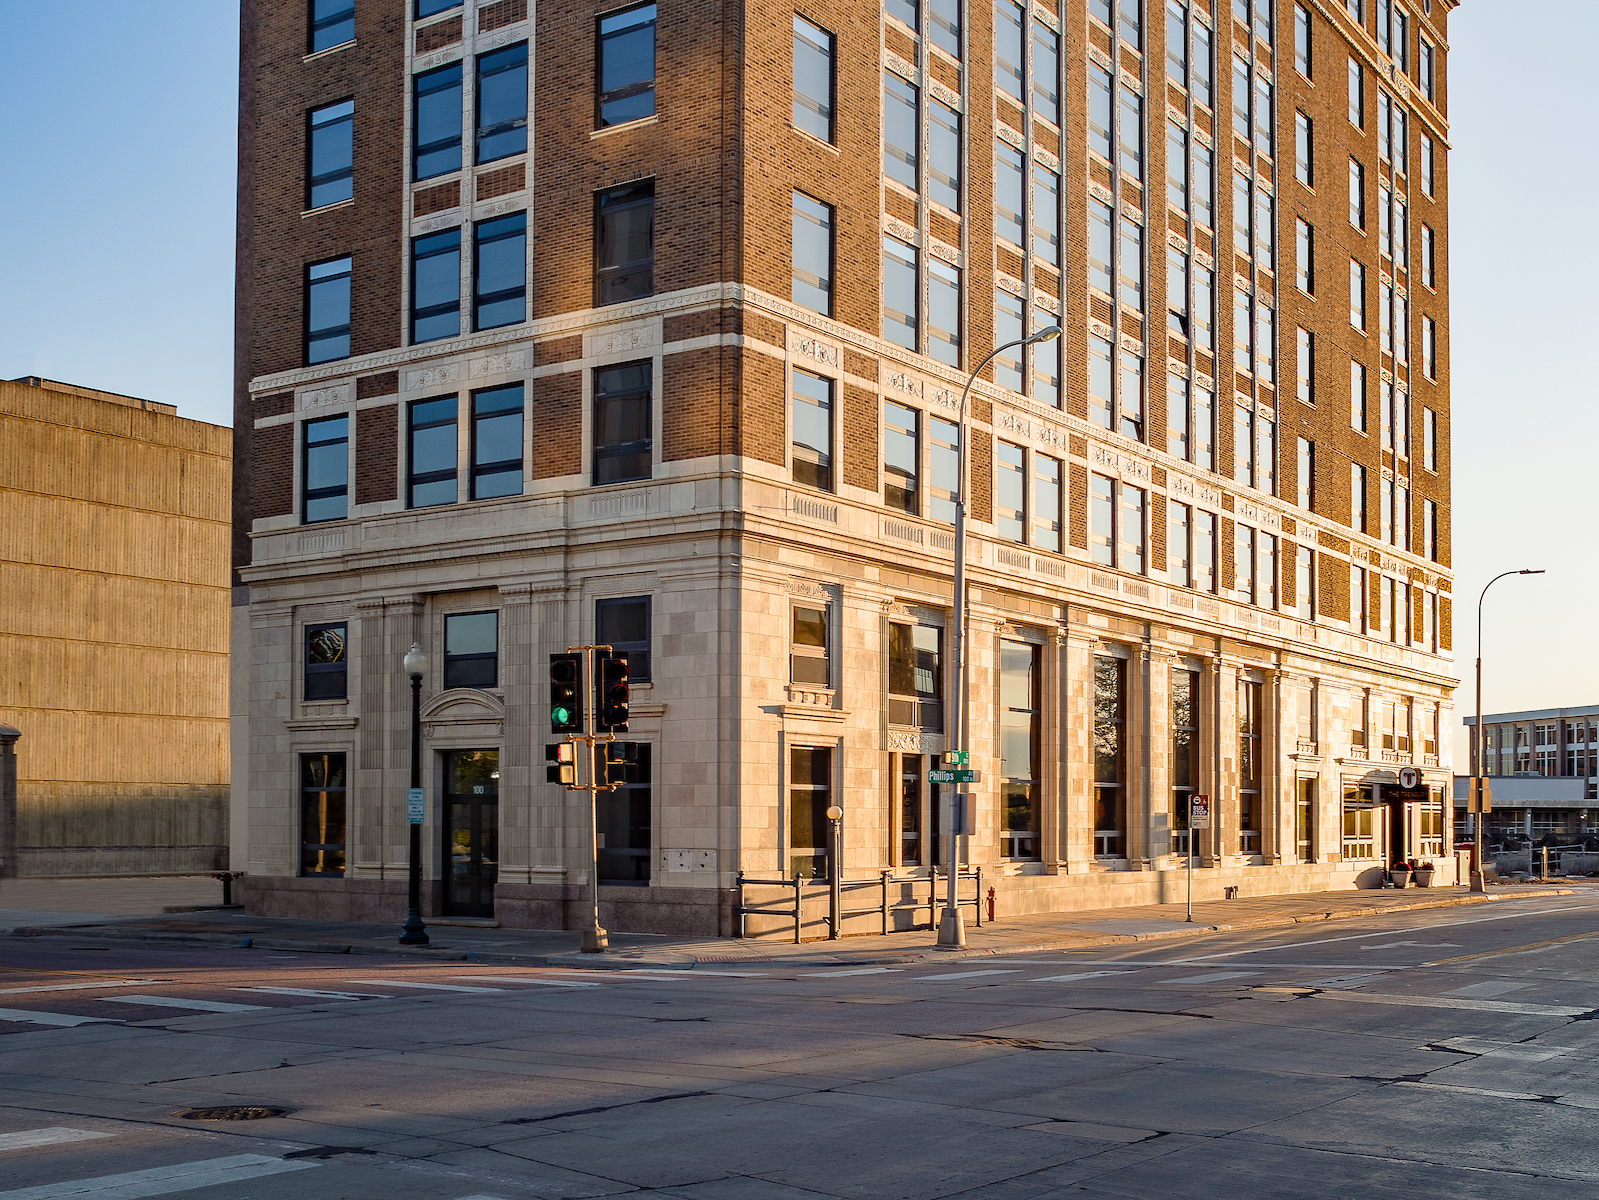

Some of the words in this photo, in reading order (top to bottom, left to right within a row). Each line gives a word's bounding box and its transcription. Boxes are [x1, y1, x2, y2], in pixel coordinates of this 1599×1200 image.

[929, 771, 954, 782] Phillips
[1404, 772, 1415, 786] T
[473, 785, 484, 794] 100
